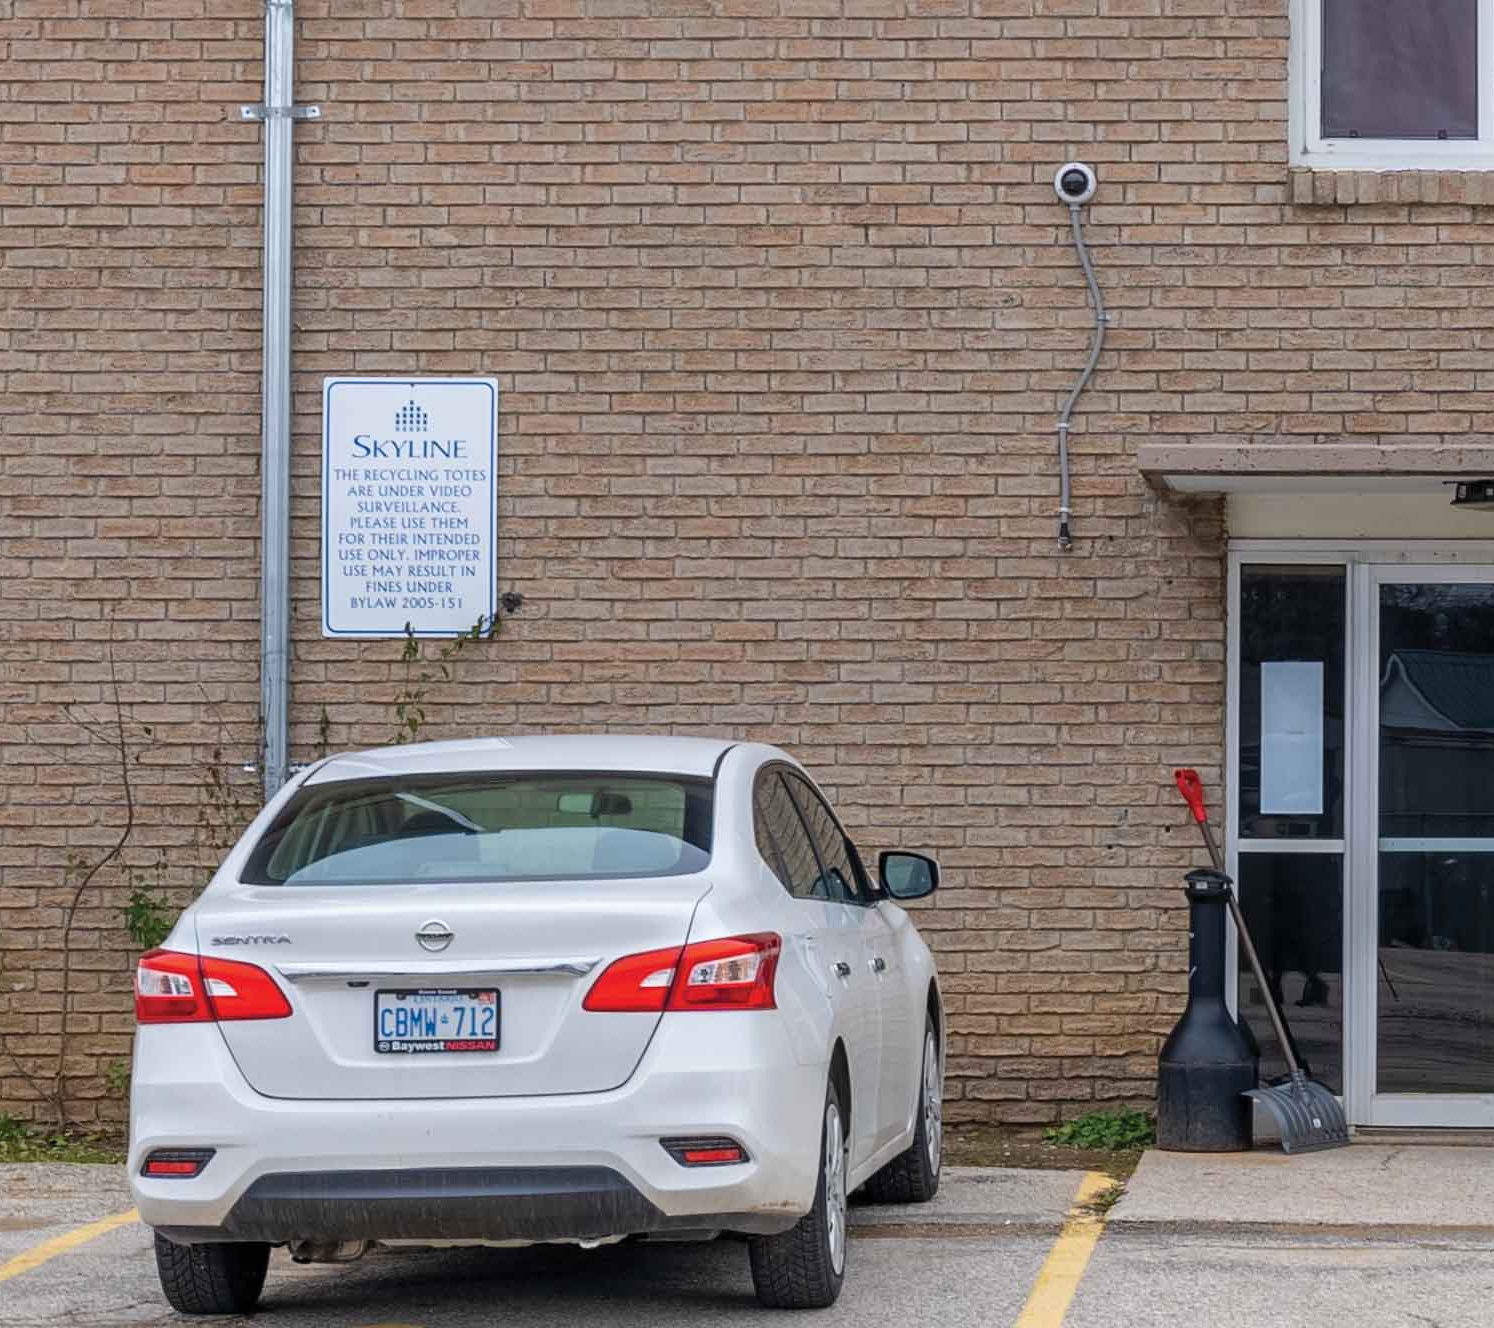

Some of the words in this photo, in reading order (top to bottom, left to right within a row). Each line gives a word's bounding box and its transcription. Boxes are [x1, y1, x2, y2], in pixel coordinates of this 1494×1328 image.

[352, 435, 468, 459] SKYLINE
[334, 469, 359, 481] THE
[364, 469, 439, 481] RECYCLING
[444, 469, 486, 481] TOTES
[347, 485, 373, 497] ARE
[378, 485, 424, 497] UNDER
[429, 485, 472, 497] VIDEO
[357, 501, 461, 513] SURVEILLANCE.
[350, 517, 397, 529] PLEASE
[402, 517, 426, 529] USE
[431, 517, 468, 529] THEM
[338, 533, 365, 545] FOR
[370, 533, 408, 545] THEIR
[413, 533, 480, 545] INTENDED
[338, 549, 363, 561] USE
[368, 549, 409, 561] ONLY.
[414, 549, 480, 561] IMPROPER
[343, 565, 367, 577] USE
[372, 565, 402, 577] MAY
[408, 565, 456, 577] RESULT
[461, 565, 475, 577] IN
[366, 581, 402, 593] FINES
[407, 581, 452, 593] UNDER
[350, 597, 397, 609] BYLAW
[402, 597, 463, 609] 2005-151
[211, 935, 293, 947] SENTRA
[381, 1007, 437, 1038] CBMW
[452, 1006, 494, 1037] 712
[392, 1040, 445, 1052] Baywest
[446, 1041, 496, 1050] NISSAN
